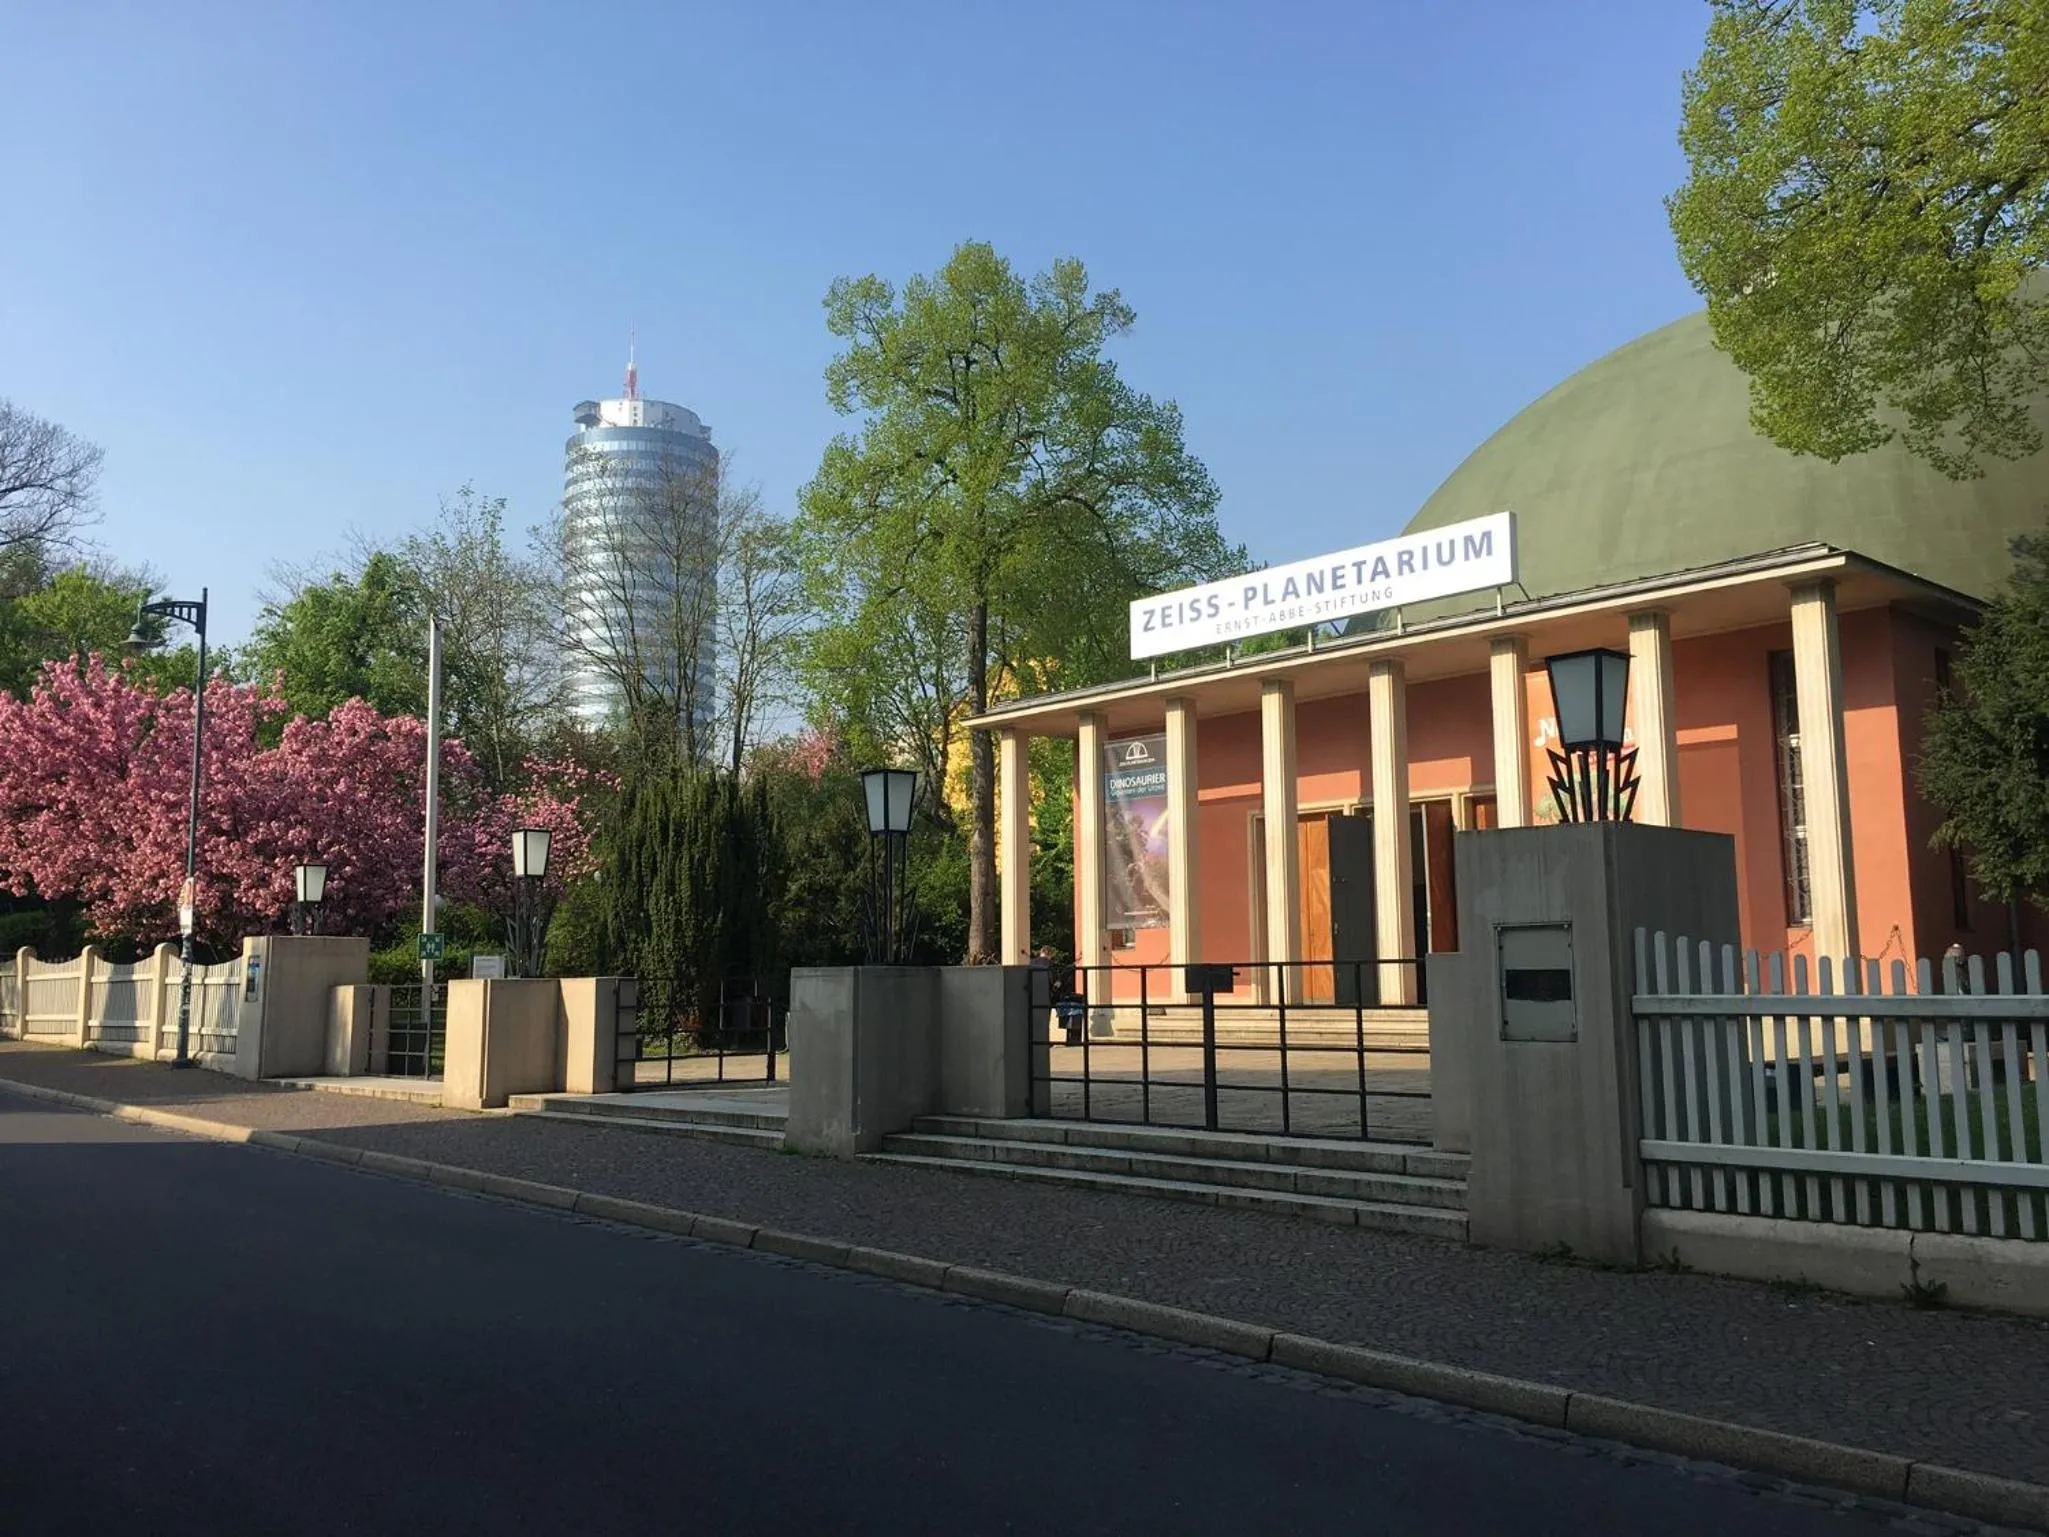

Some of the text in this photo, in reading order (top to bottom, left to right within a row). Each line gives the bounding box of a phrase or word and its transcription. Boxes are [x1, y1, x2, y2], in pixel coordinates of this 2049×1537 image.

[1143, 530, 1493, 632] ZEISS-PLANETARIUM
[1216, 586, 1393, 635] ERNST-ABBE-STIFTUNG
[1110, 772, 1165, 790] DINOSAURIER
